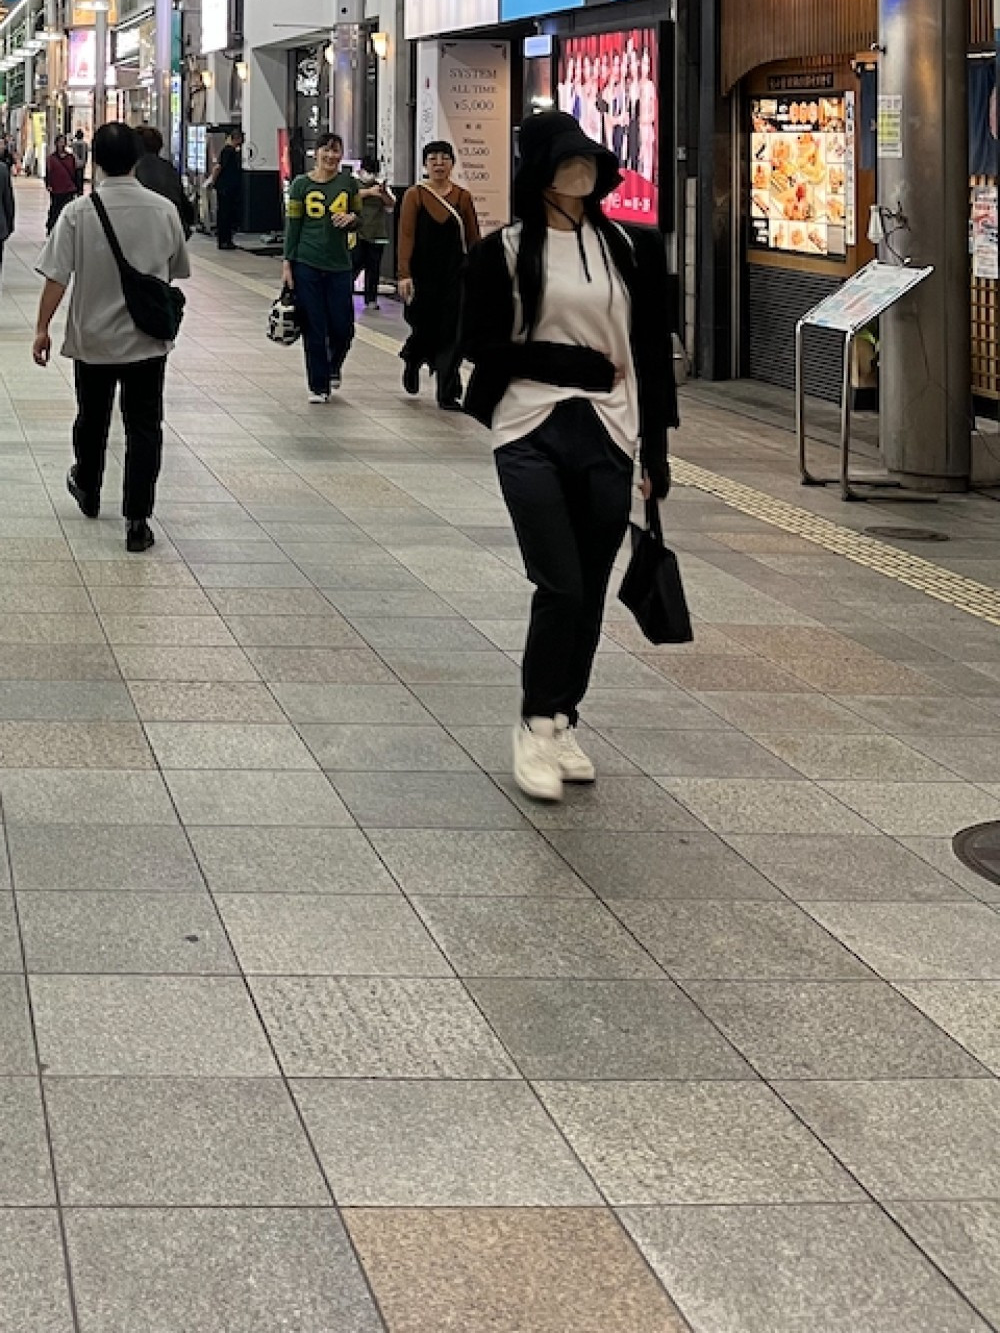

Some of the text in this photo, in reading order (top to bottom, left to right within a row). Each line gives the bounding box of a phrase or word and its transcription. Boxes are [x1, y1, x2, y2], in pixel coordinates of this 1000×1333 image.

[449, 68, 497, 80] SYSTEM
[449, 84, 498, 94] ALL TIME
[304, 190, 349, 219] 64
